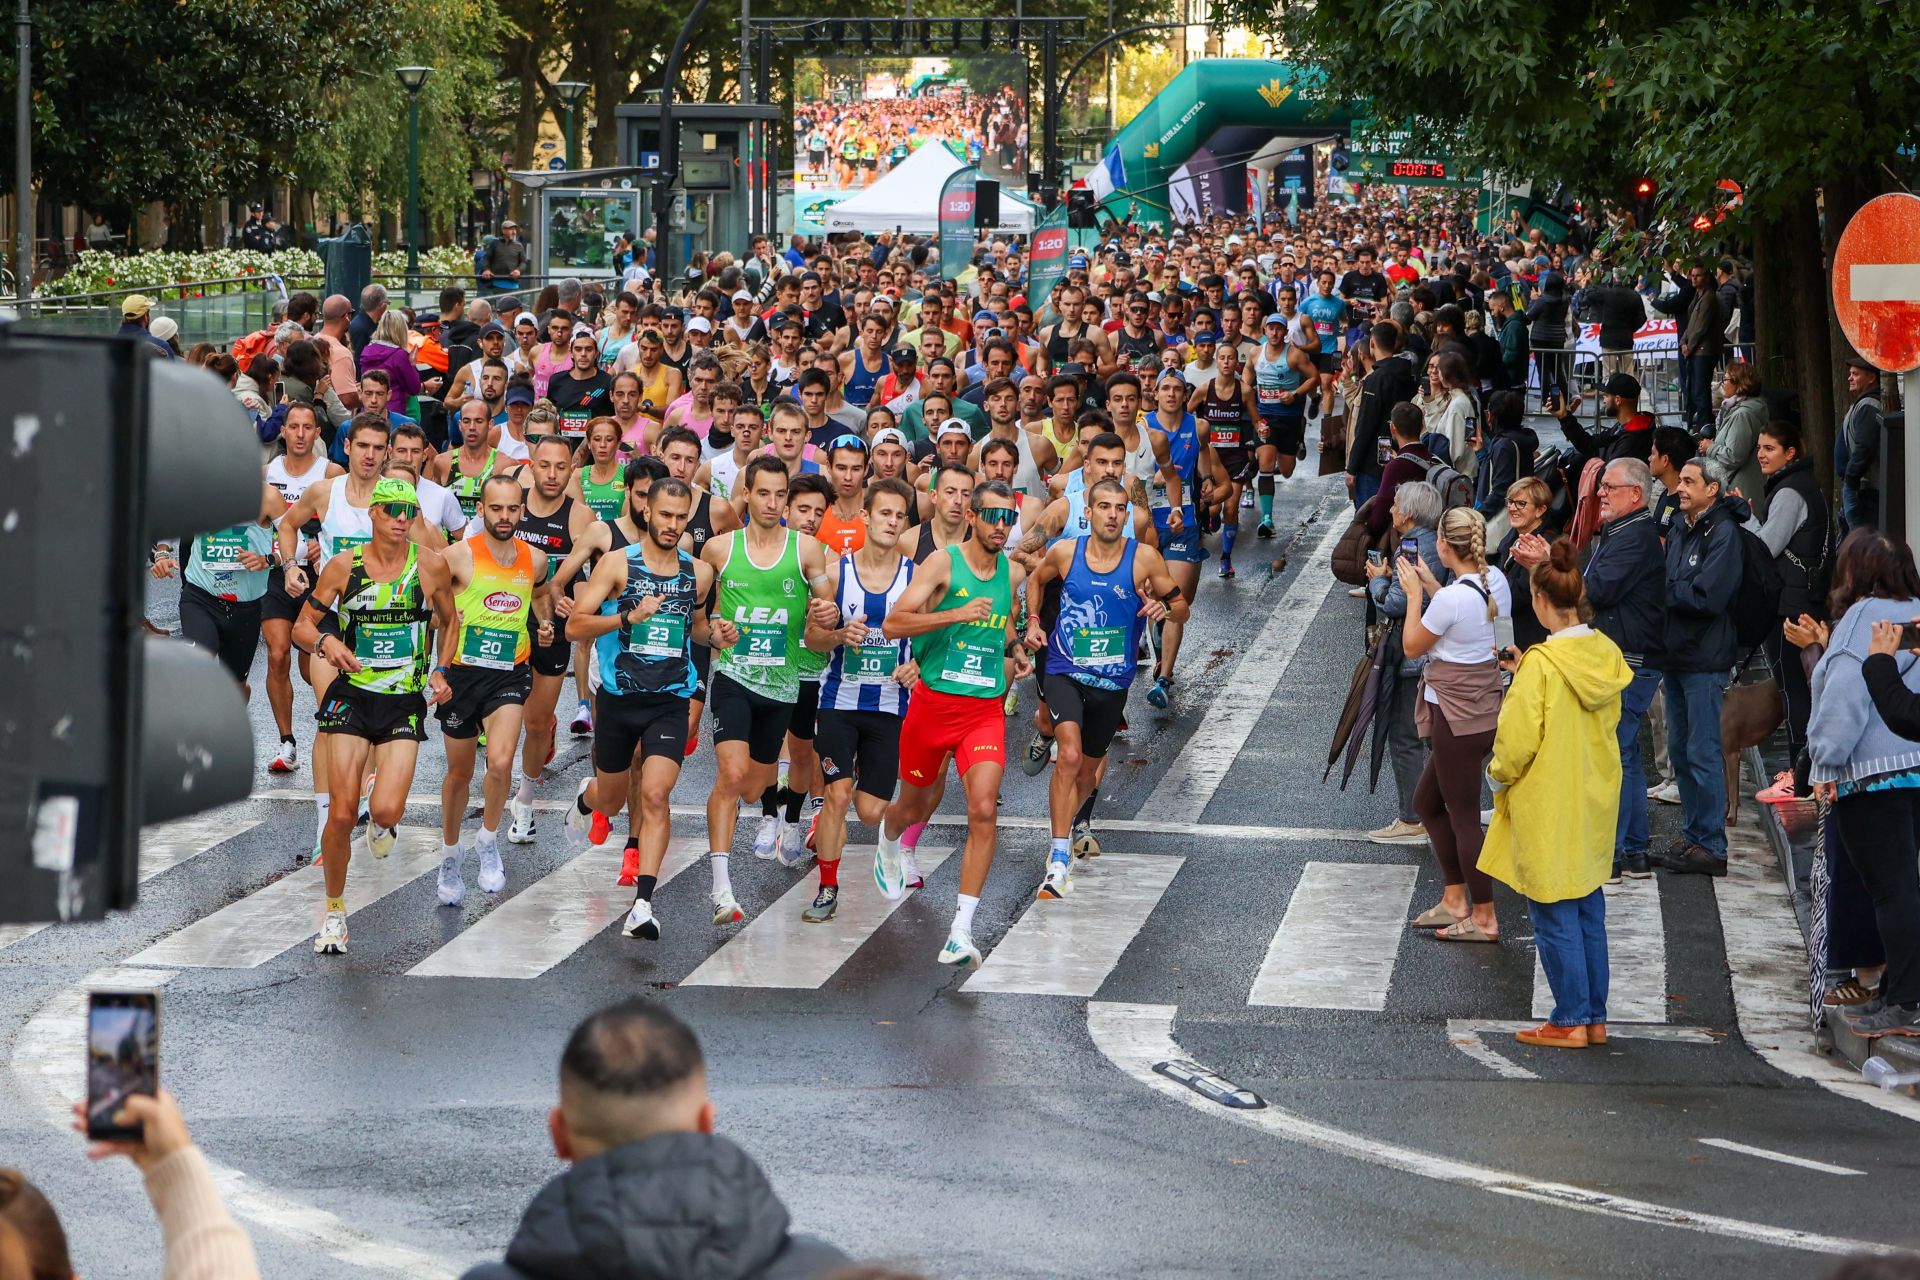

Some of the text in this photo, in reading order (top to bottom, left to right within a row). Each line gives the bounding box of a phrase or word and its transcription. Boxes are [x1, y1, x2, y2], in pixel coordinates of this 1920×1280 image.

[1160, 122, 1183, 145] RURAL
[1393, 163, 1445, 177] 0:00:15
[563, 418, 588, 428] 2557
[1217, 431, 1233, 440] 110
[487, 597, 520, 609] Serrano
[734, 605, 789, 625] LEA
[648, 626, 670, 642] 23
[372, 640, 395, 654] 22
[479, 639, 502, 655] 20
[749, 637, 772, 652] 24
[1089, 638, 1110, 653] 27
[860, 658, 881, 672] 10
[963, 654, 982, 670] 21
